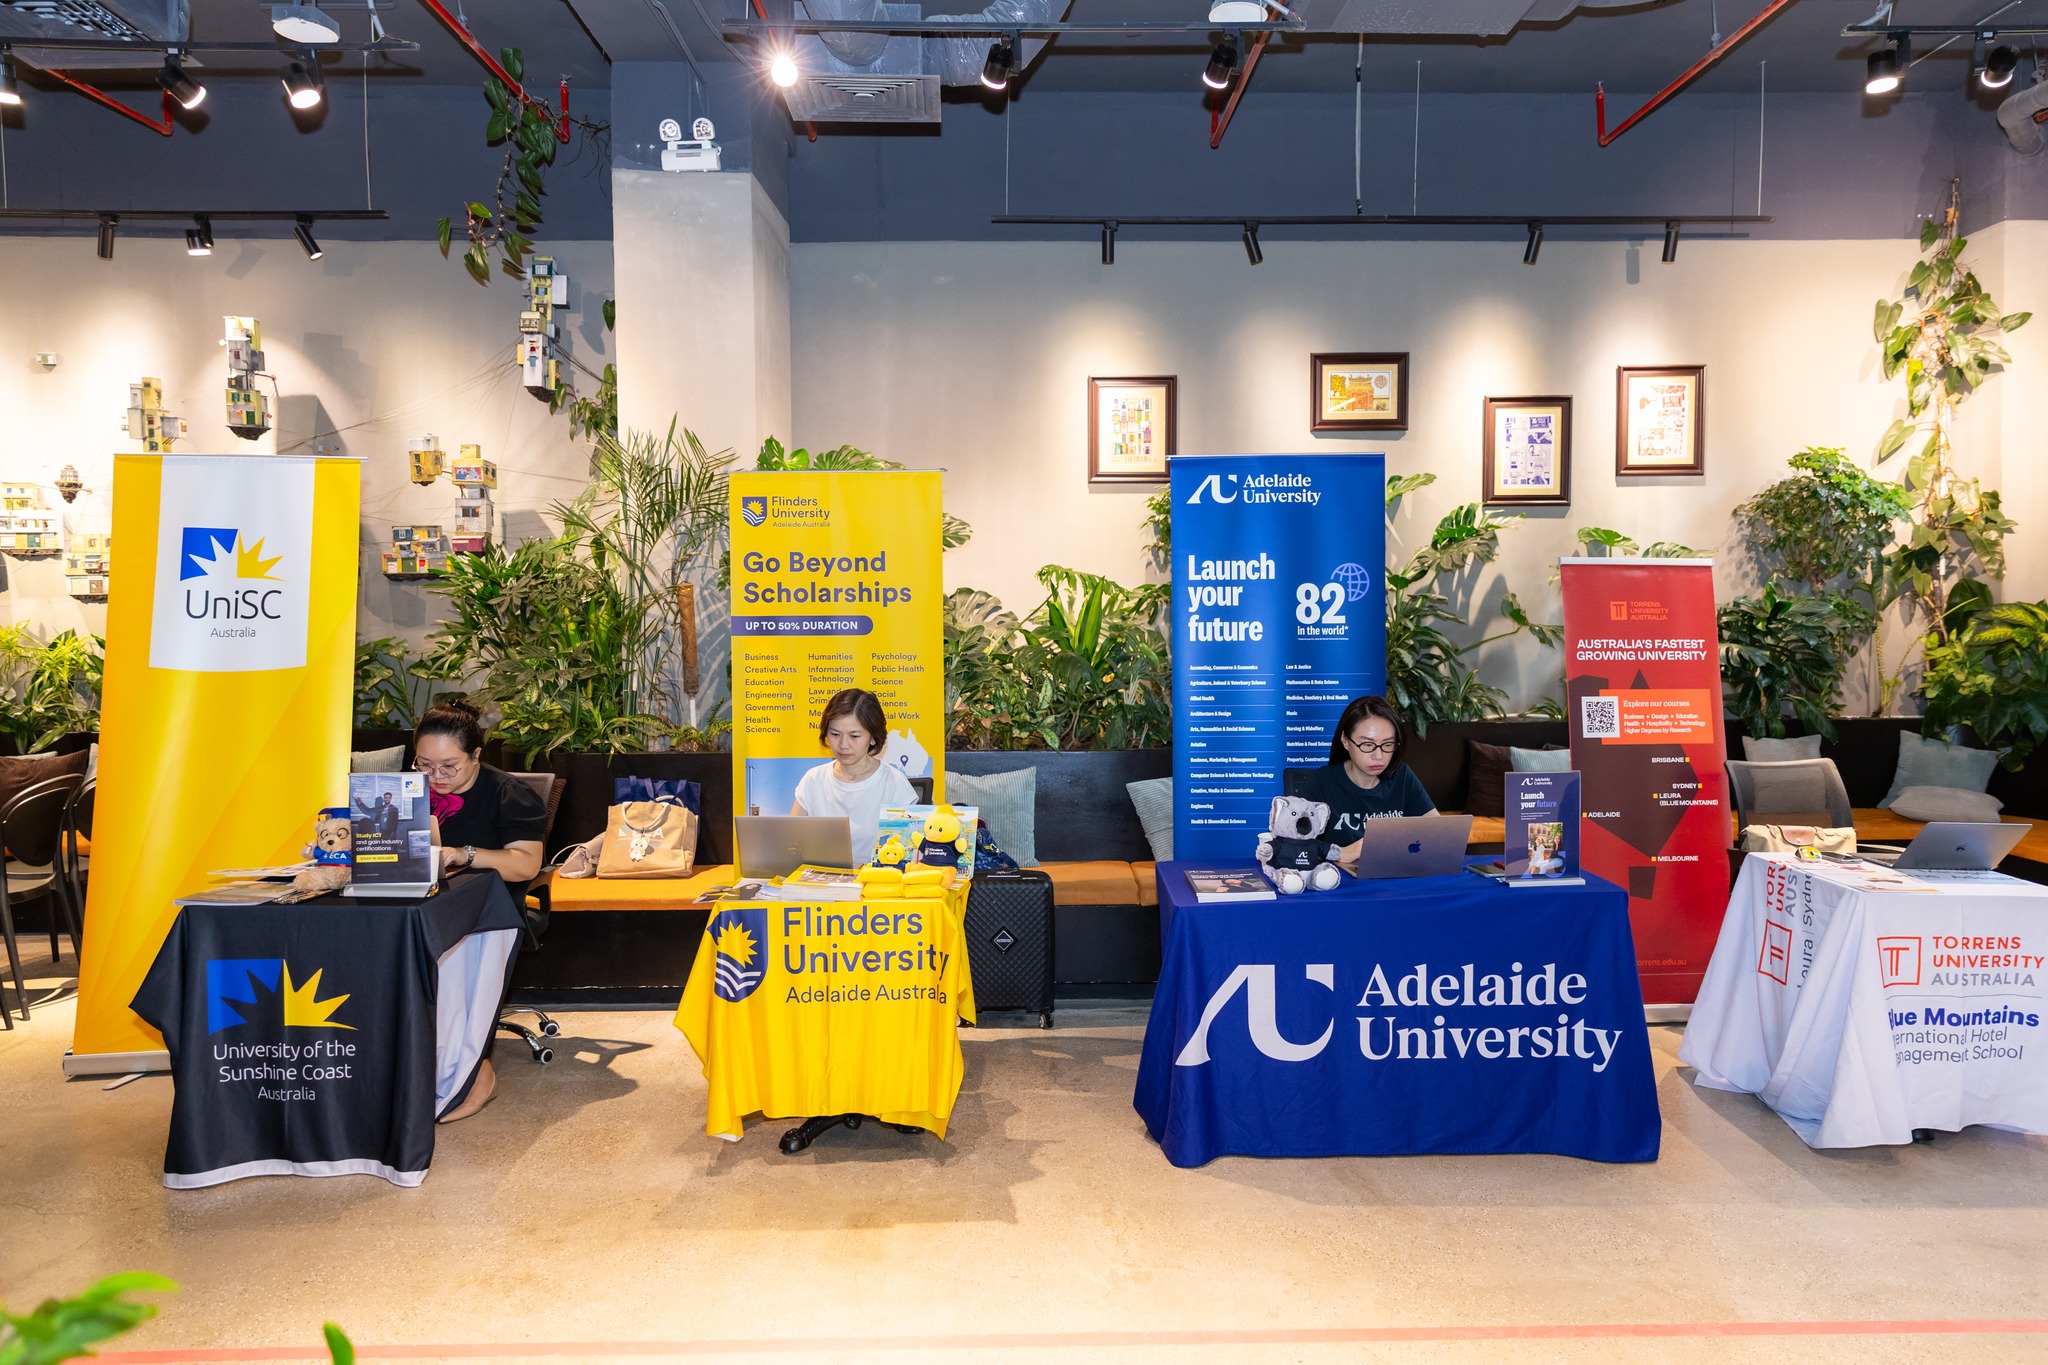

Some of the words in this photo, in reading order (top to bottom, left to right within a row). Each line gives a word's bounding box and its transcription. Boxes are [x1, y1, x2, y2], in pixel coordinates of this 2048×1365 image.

[1243, 474, 1311, 488] Adelaide
[772, 496, 817, 506] Flinders
[1243, 489, 1321, 506] University
[772, 508, 830, 520] University
[743, 552, 780, 573] Go
[790, 551, 886, 577] Beyond
[1188, 553, 1275, 581] Launch
[743, 582, 911, 607] Scholarships
[1188, 586, 1243, 612] your
[185, 589, 282, 619] UniSC
[1296, 583, 1346, 625] 82
[210, 627, 256, 638] Australia
[746, 622, 759, 630] UP
[761, 622, 775, 630] TO
[778, 621, 800, 630] 50%
[803, 621, 858, 630] DURATION
[1188, 615, 1263, 642] future
[1297, 625, 1305, 635] in
[1306, 625, 1320, 635] the
[1577, 639, 1652, 649] AUSTRALIA'S
[1655, 639, 1705, 648] FASTEST
[745, 653, 778, 661] Business
[872, 653, 917, 661] Psychology
[1576, 651, 1636, 661] GROWING
[1638, 651, 1707, 660] UNIVERSITY
[809, 675, 854, 683] Technology
[746, 691, 792, 699] Engineering
[1623, 700, 1649, 708] Explore
[1521, 792, 1544, 800] Launch
[1521, 801, 1536, 810] your
[784, 906, 923, 937] Flinders
[1933, 936, 2021, 950] TORRENS
[784, 941, 950, 981] University
[1637, 957, 1686, 966] orrens.edu.au
[1933, 954, 2045, 969] UNIVERSITY
[1356, 962, 1586, 1006] Adelaide
[1931, 972, 2035, 987] AUSTRALIA
[786, 984, 871, 1003] Adelaide
[1924, 1005, 2039, 1027] Mountains
[1971, 1026, 2007, 1043] Hotel
[214, 1042, 300, 1061] University
[304, 1041, 323, 1058] of
[326, 1040, 356, 1057] the
[1356, 1014, 1623, 1073] University
[1972, 1045, 2023, 1060] School
[219, 1063, 297, 1082] Sunshine
[302, 1063, 352, 1080] Coast
[258, 1086, 316, 1101] Australia
